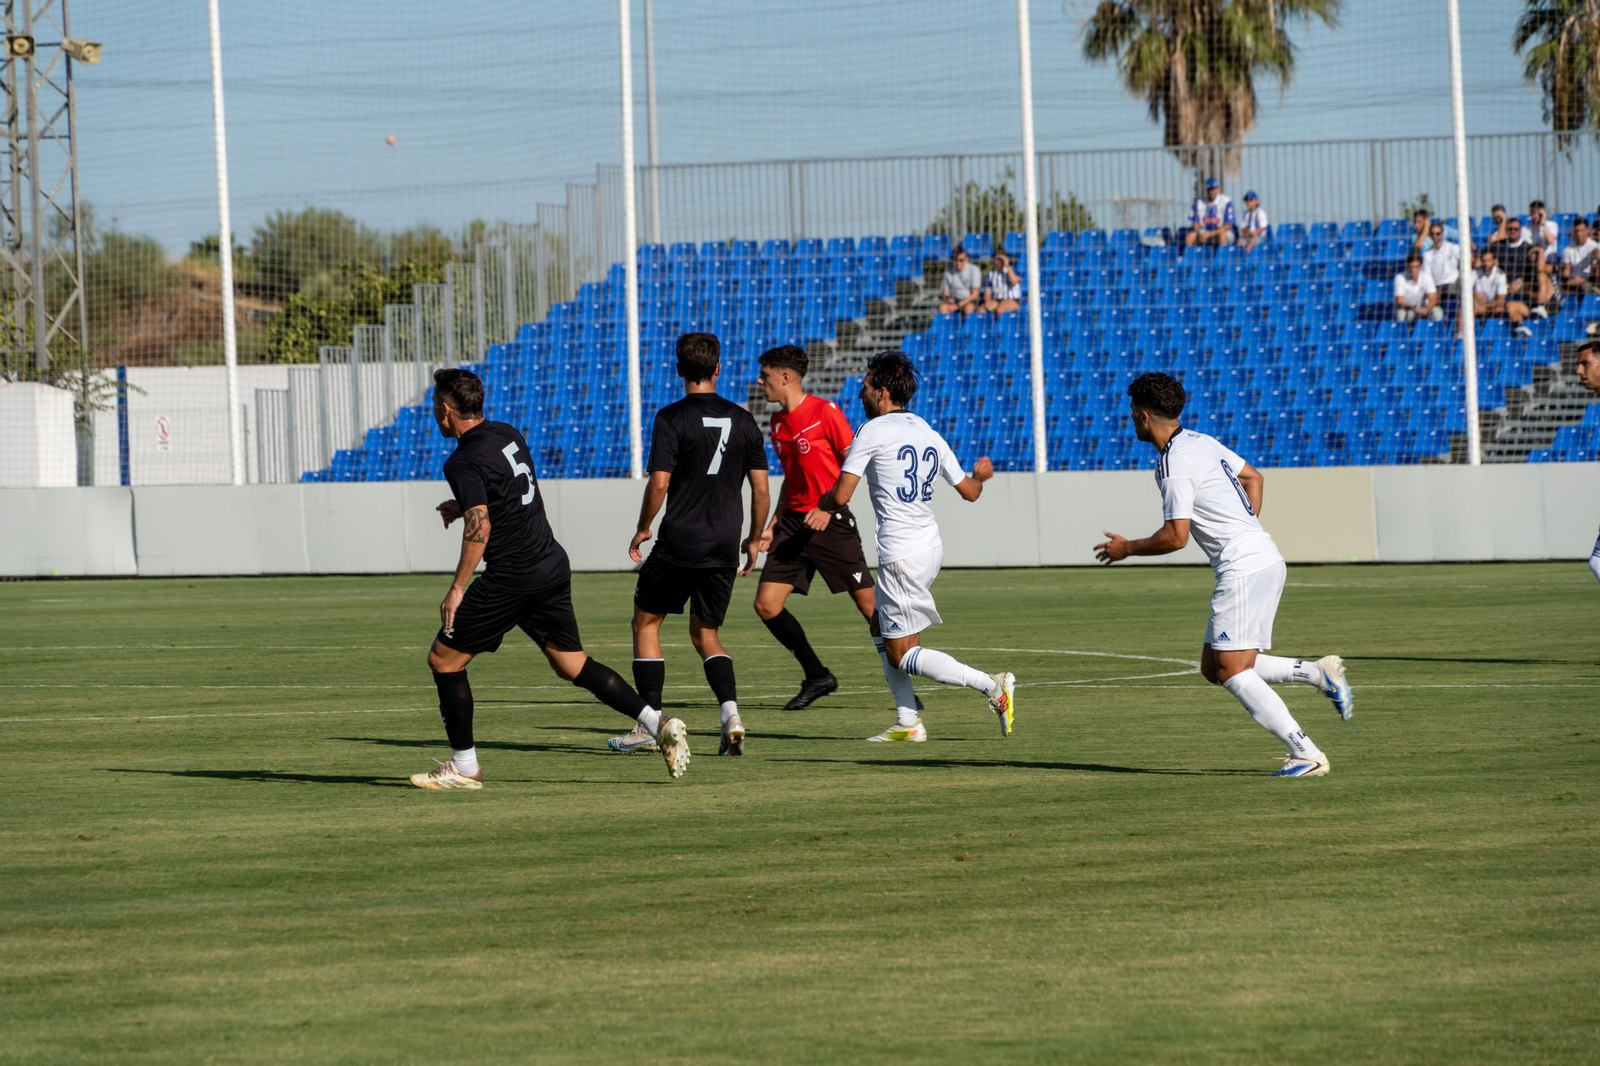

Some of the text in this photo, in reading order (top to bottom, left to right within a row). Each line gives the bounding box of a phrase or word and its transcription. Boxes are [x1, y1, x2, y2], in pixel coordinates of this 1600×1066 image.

[501, 441, 535, 505] 5
[702, 417, 732, 475] 7
[896, 445, 939, 503] 32
[1220, 459, 1255, 516] 6
